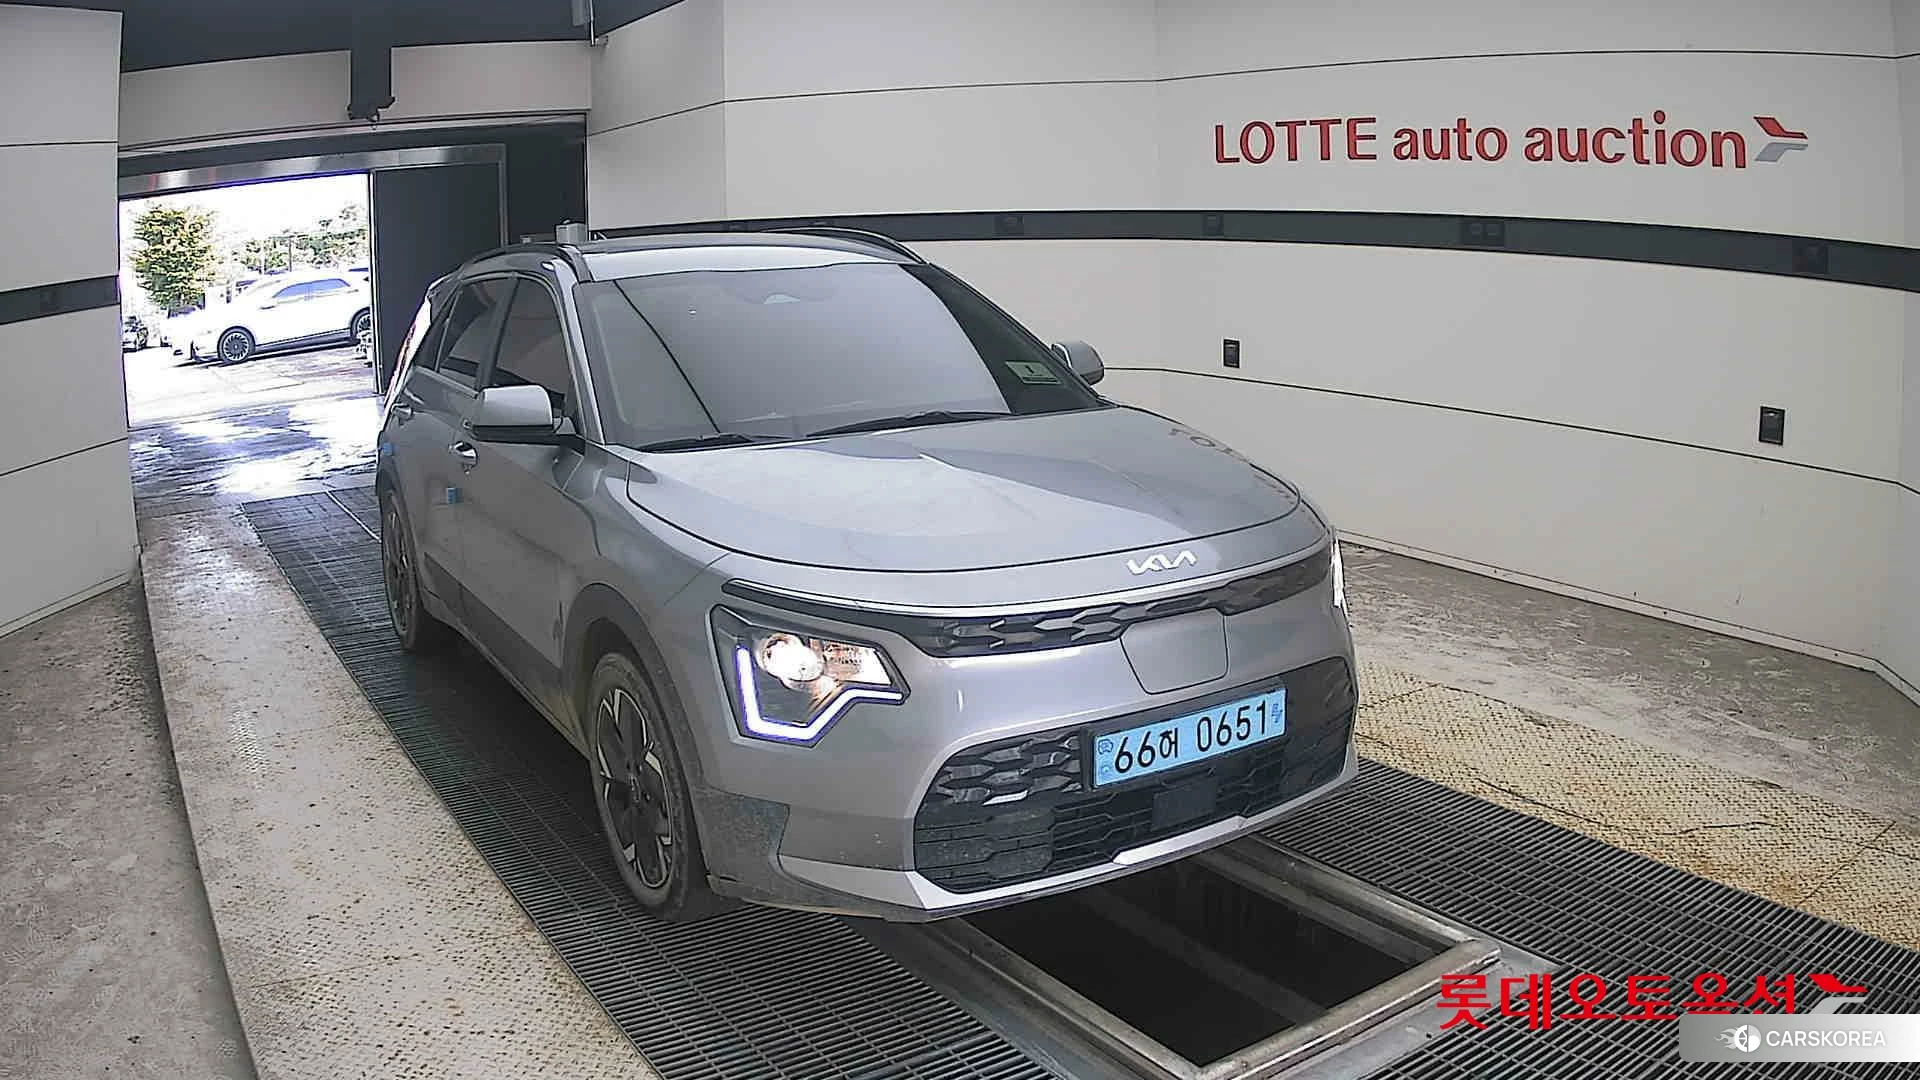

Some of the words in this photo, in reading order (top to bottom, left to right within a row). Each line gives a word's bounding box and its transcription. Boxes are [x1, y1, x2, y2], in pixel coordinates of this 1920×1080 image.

[1214, 116, 1378, 164] LOTTE
[1392, 117, 1508, 162] auto
[1523, 109, 1747, 169] auction
[1114, 726, 1179, 774] 66허
[1196, 699, 1267, 753] 0651
